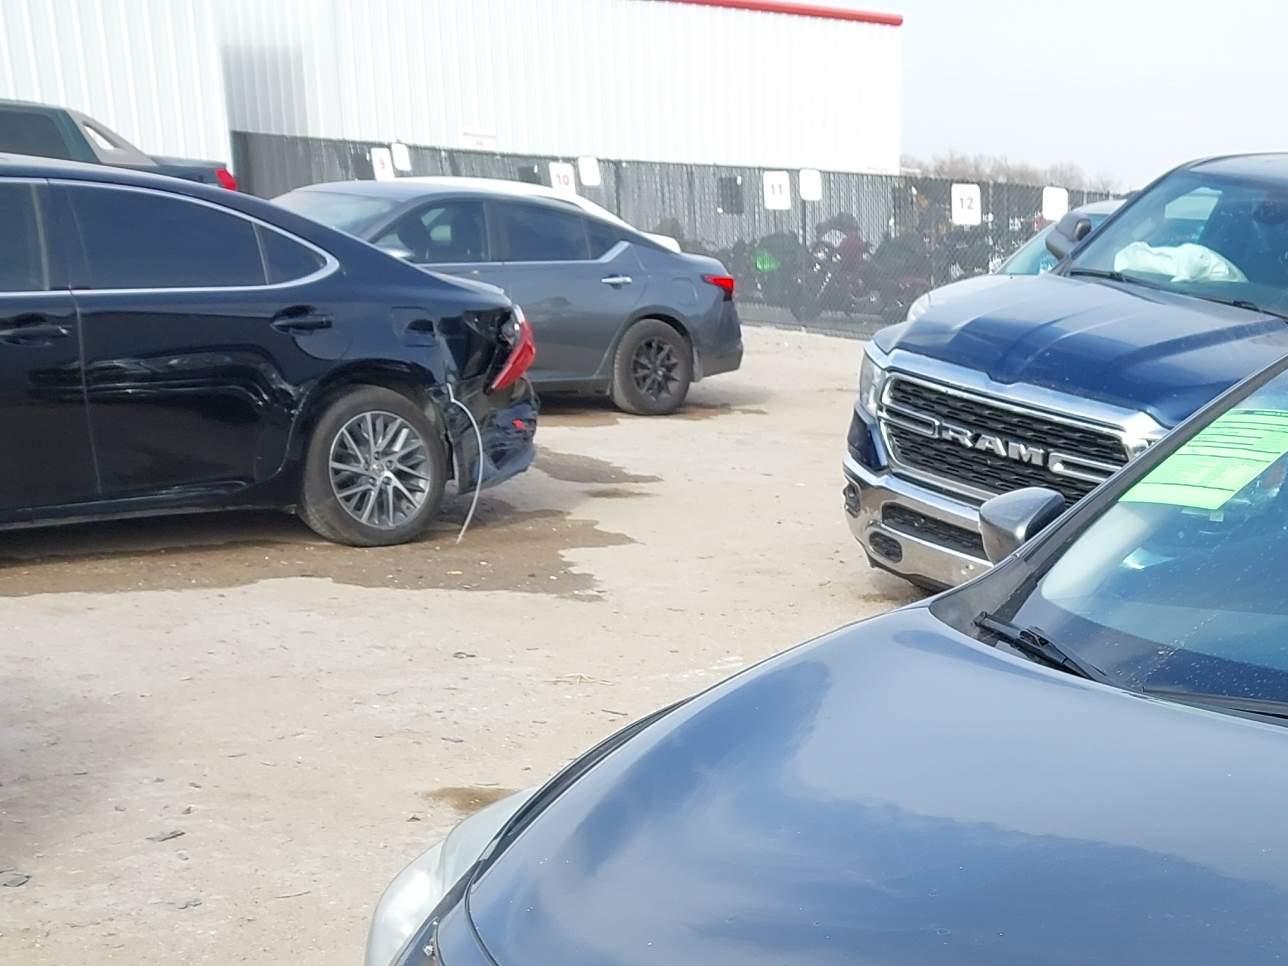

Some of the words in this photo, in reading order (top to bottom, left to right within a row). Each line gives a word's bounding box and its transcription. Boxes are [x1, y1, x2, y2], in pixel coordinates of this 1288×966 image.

[556, 173, 570, 186] 10
[770, 183, 785, 196] 11
[958, 196, 975, 210] 12
[940, 420, 1044, 467] RAM
